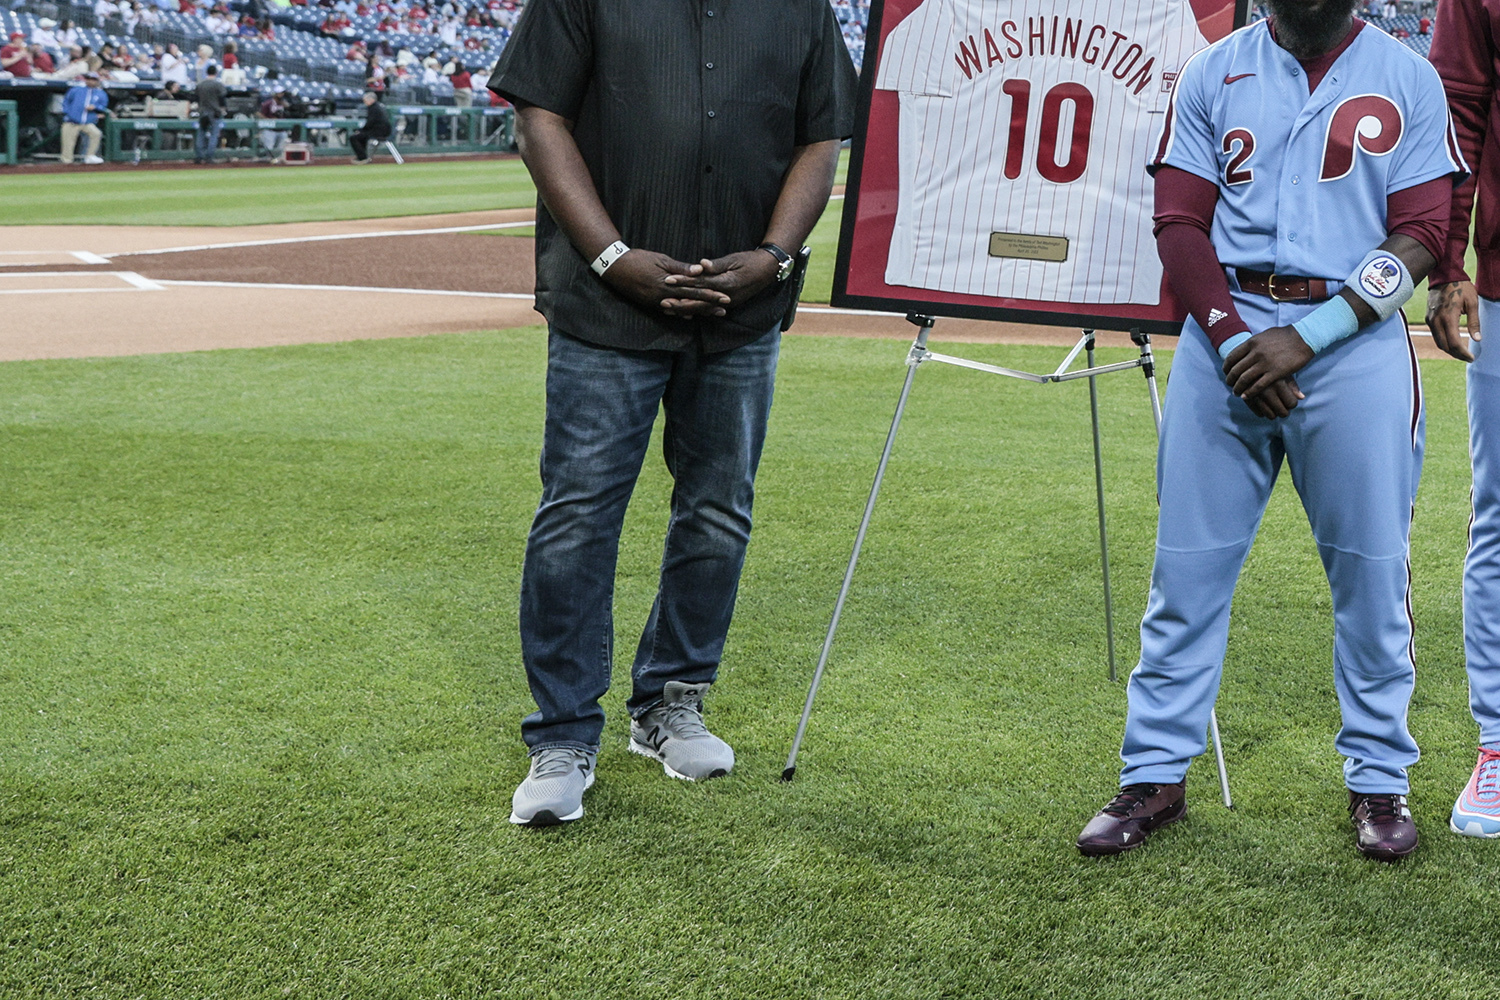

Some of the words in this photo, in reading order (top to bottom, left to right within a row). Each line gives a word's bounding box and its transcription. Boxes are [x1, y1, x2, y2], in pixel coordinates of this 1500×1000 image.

[954, 14, 1156, 98] WASHINGTON
[1002, 78, 1094, 184] 10
[1221, 127, 1257, 187] 2
[1319, 93, 1405, 183] P
